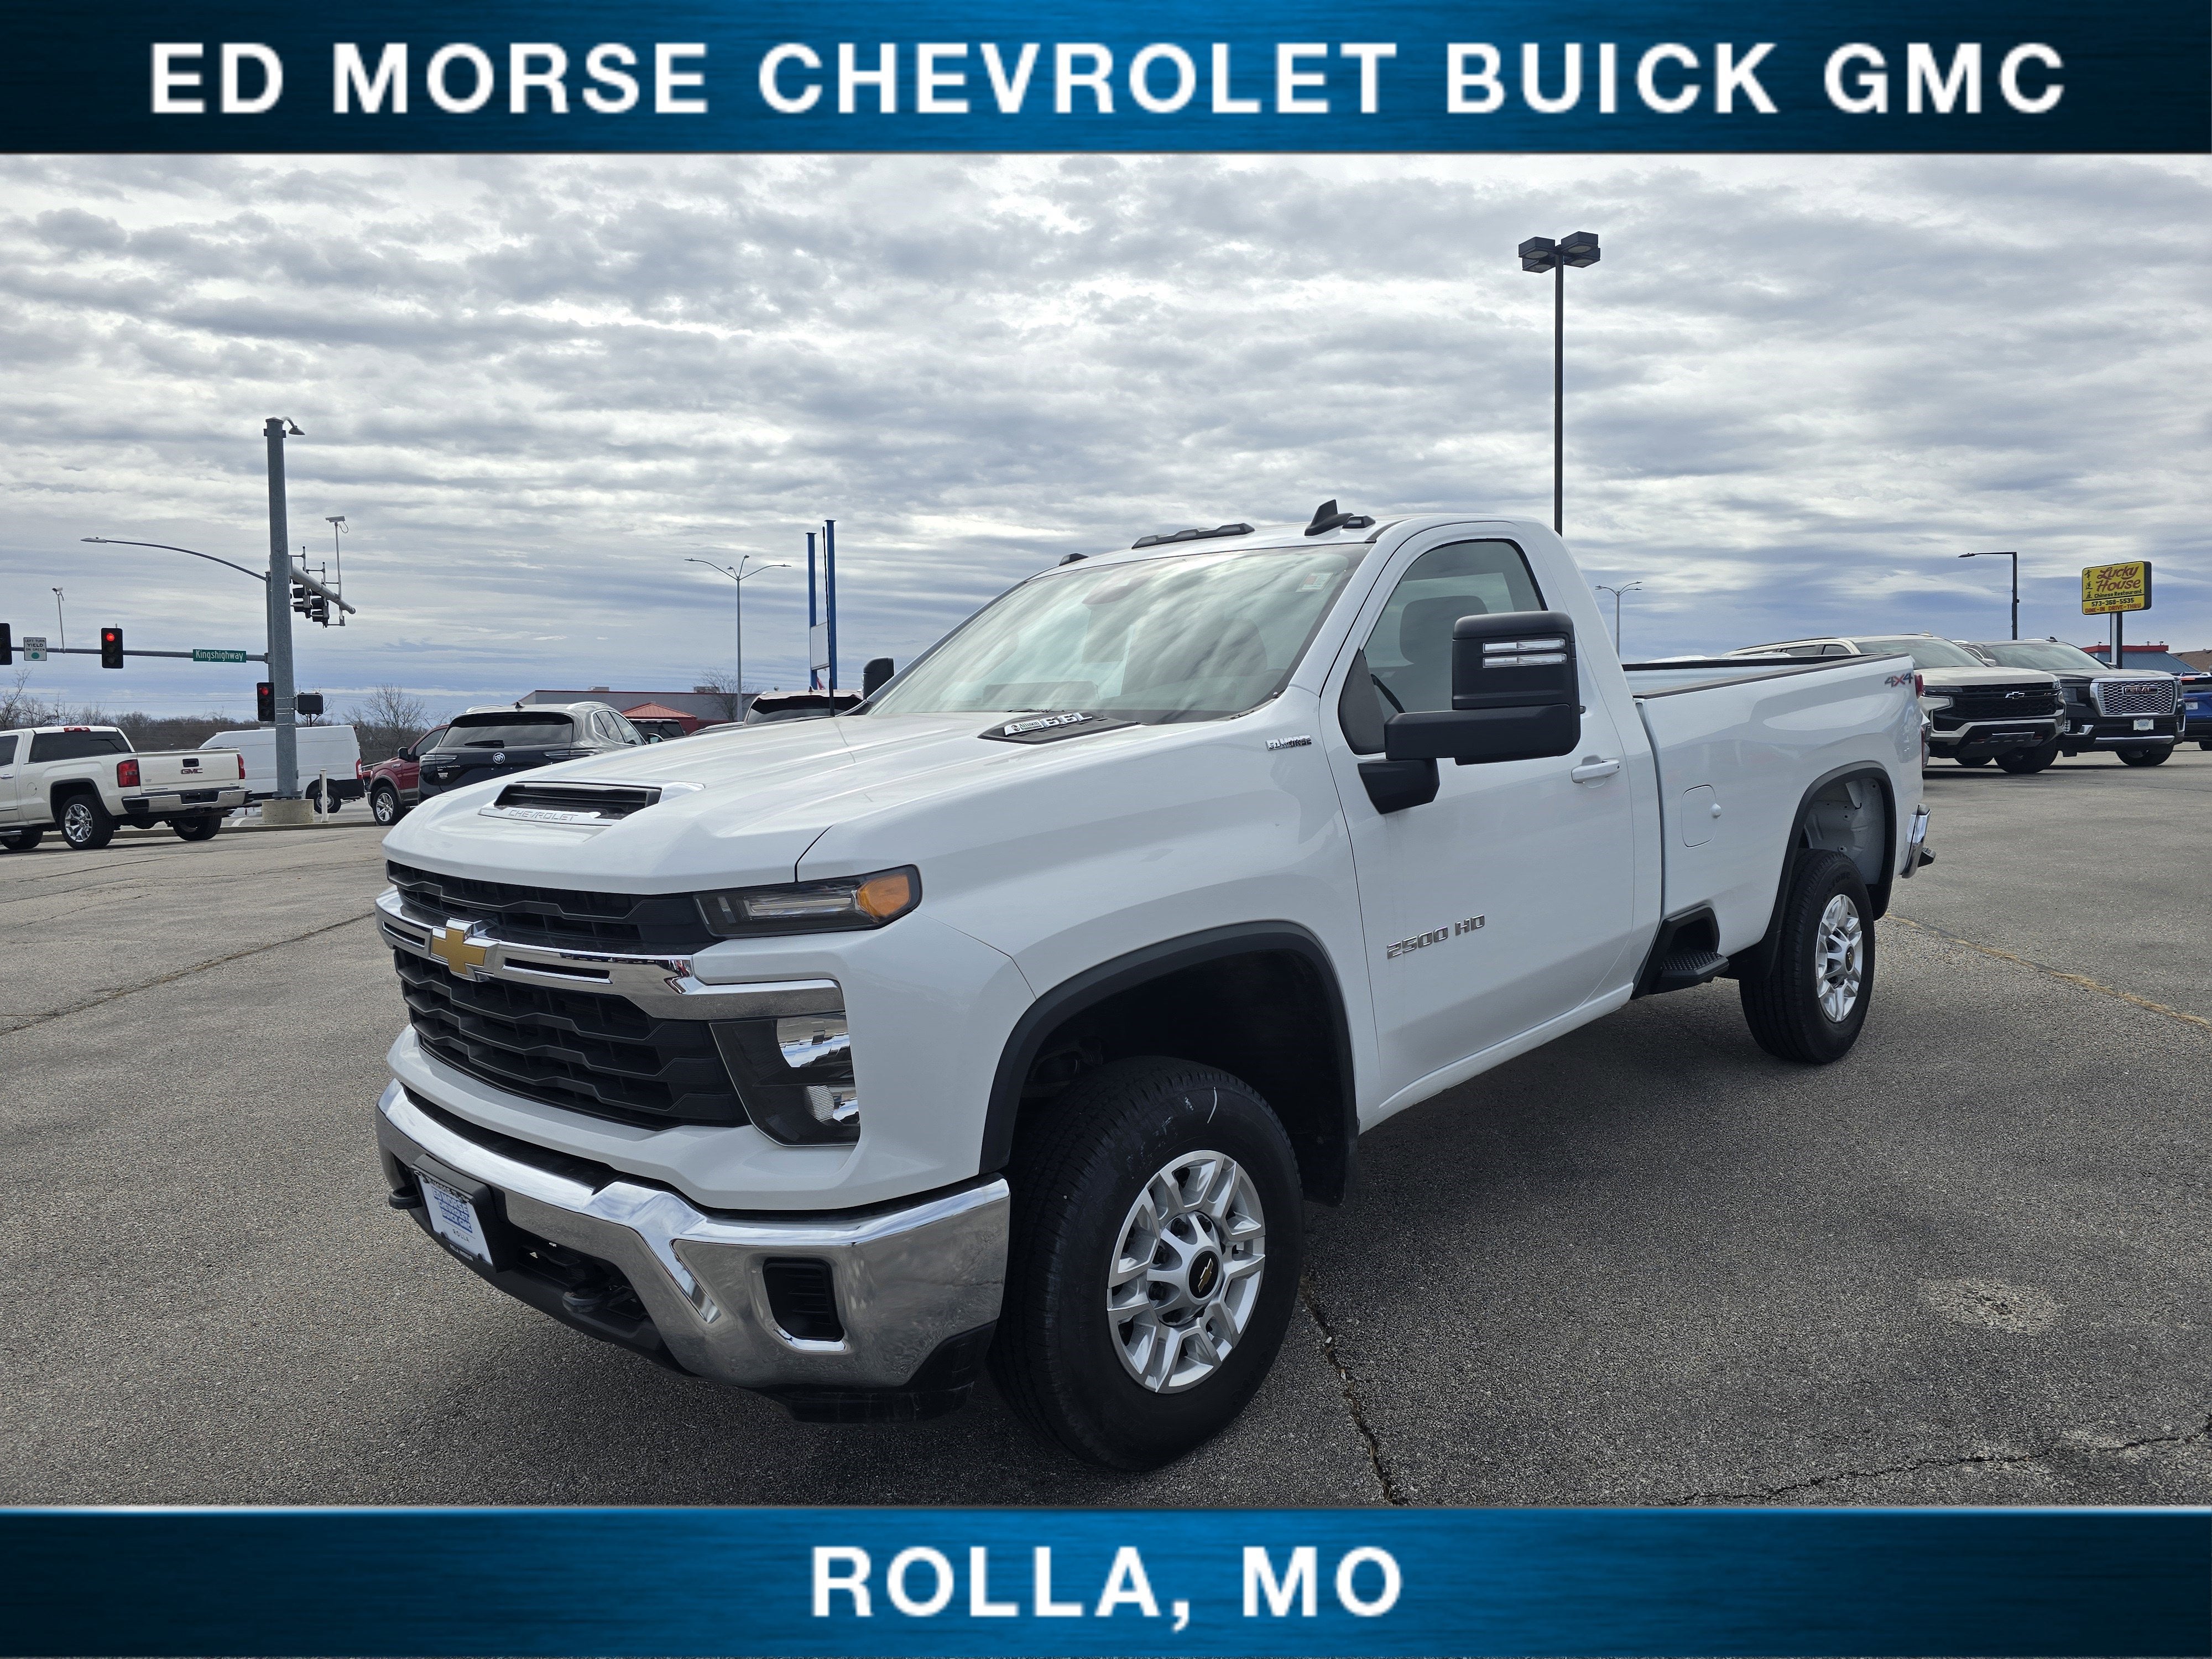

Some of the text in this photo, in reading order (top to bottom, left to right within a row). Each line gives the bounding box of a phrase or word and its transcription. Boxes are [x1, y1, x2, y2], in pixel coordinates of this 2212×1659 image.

[2097, 565, 2139, 580] Lucky
[2096, 579, 2141, 593] House
[2091, 597, 2135, 607] 573-368-5535
[2108, 603, 2141, 611] DRIVE-THRU
[195, 650, 243, 661] Kingshighway
[509, 810, 579, 821] CHEVROLET
[1386, 914, 1485, 959] 2500 HD
[432, 1187, 443, 1201] ED
[440, 1191, 469, 1215] MORSE
[438, 1199, 470, 1223] CHEVROLET
[441, 1207, 473, 1233] BUICK GMC
[452, 1228, 469, 1243] ROLLA
